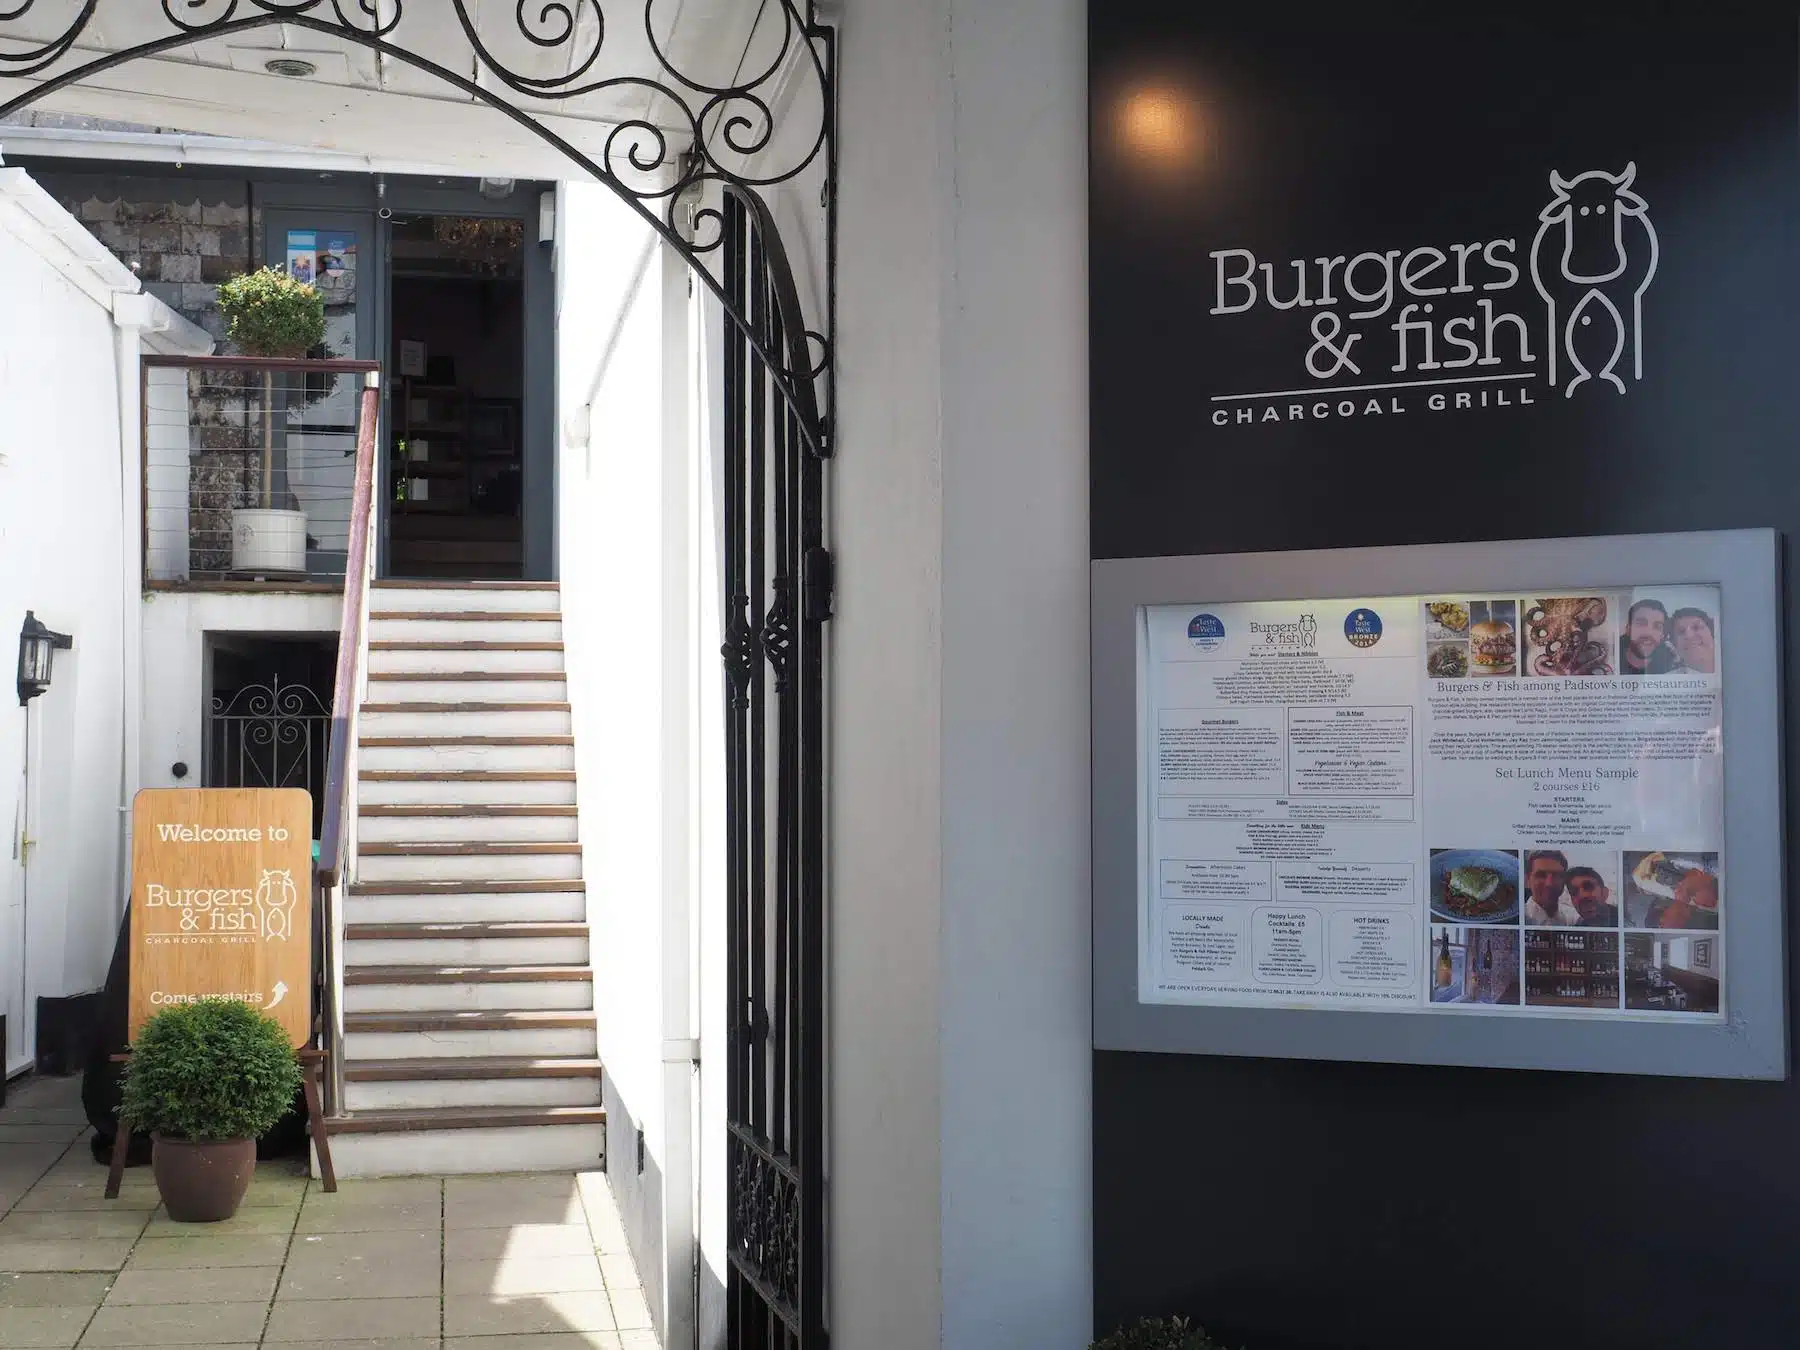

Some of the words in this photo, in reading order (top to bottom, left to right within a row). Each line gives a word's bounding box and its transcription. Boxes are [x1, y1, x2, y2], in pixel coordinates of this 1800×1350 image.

[1210, 238, 1519, 320] Burgers
[1305, 311, 1362, 379] &
[1391, 298, 1537, 373] fish
[1212, 396, 1405, 426] CHARCOAL
[1427, 388, 1534, 411] GRILL
[1250, 622, 1297, 636] Burgers
[1266, 633, 1275, 644] &
[1279, 632, 1300, 644] fish
[1437, 681, 1479, 694] Burgers
[1482, 680, 1493, 691] &
[1497, 680, 1520, 691] Fish
[1523, 682, 1561, 694] among
[1564, 679, 1617, 691] Padstow's
[1621, 680, 1638, 692] top
[1642, 679, 1708, 690] restaurants
[1495, 767, 1514, 778] Set
[1518, 767, 1554, 778] Lunch
[1558, 768, 1592, 778] Menu
[1595, 767, 1640, 781] Sample
[1533, 782, 1540, 791] 2
[1542, 783, 1579, 791] courses
[1581, 781, 1600, 791] £16
[156, 823, 262, 843] Welcome
[267, 826, 288, 842] to
[146, 884, 253, 912] Burgers
[179, 907, 200, 930] &
[209, 907, 258, 930] fish
[150, 991, 197, 1005] Come
